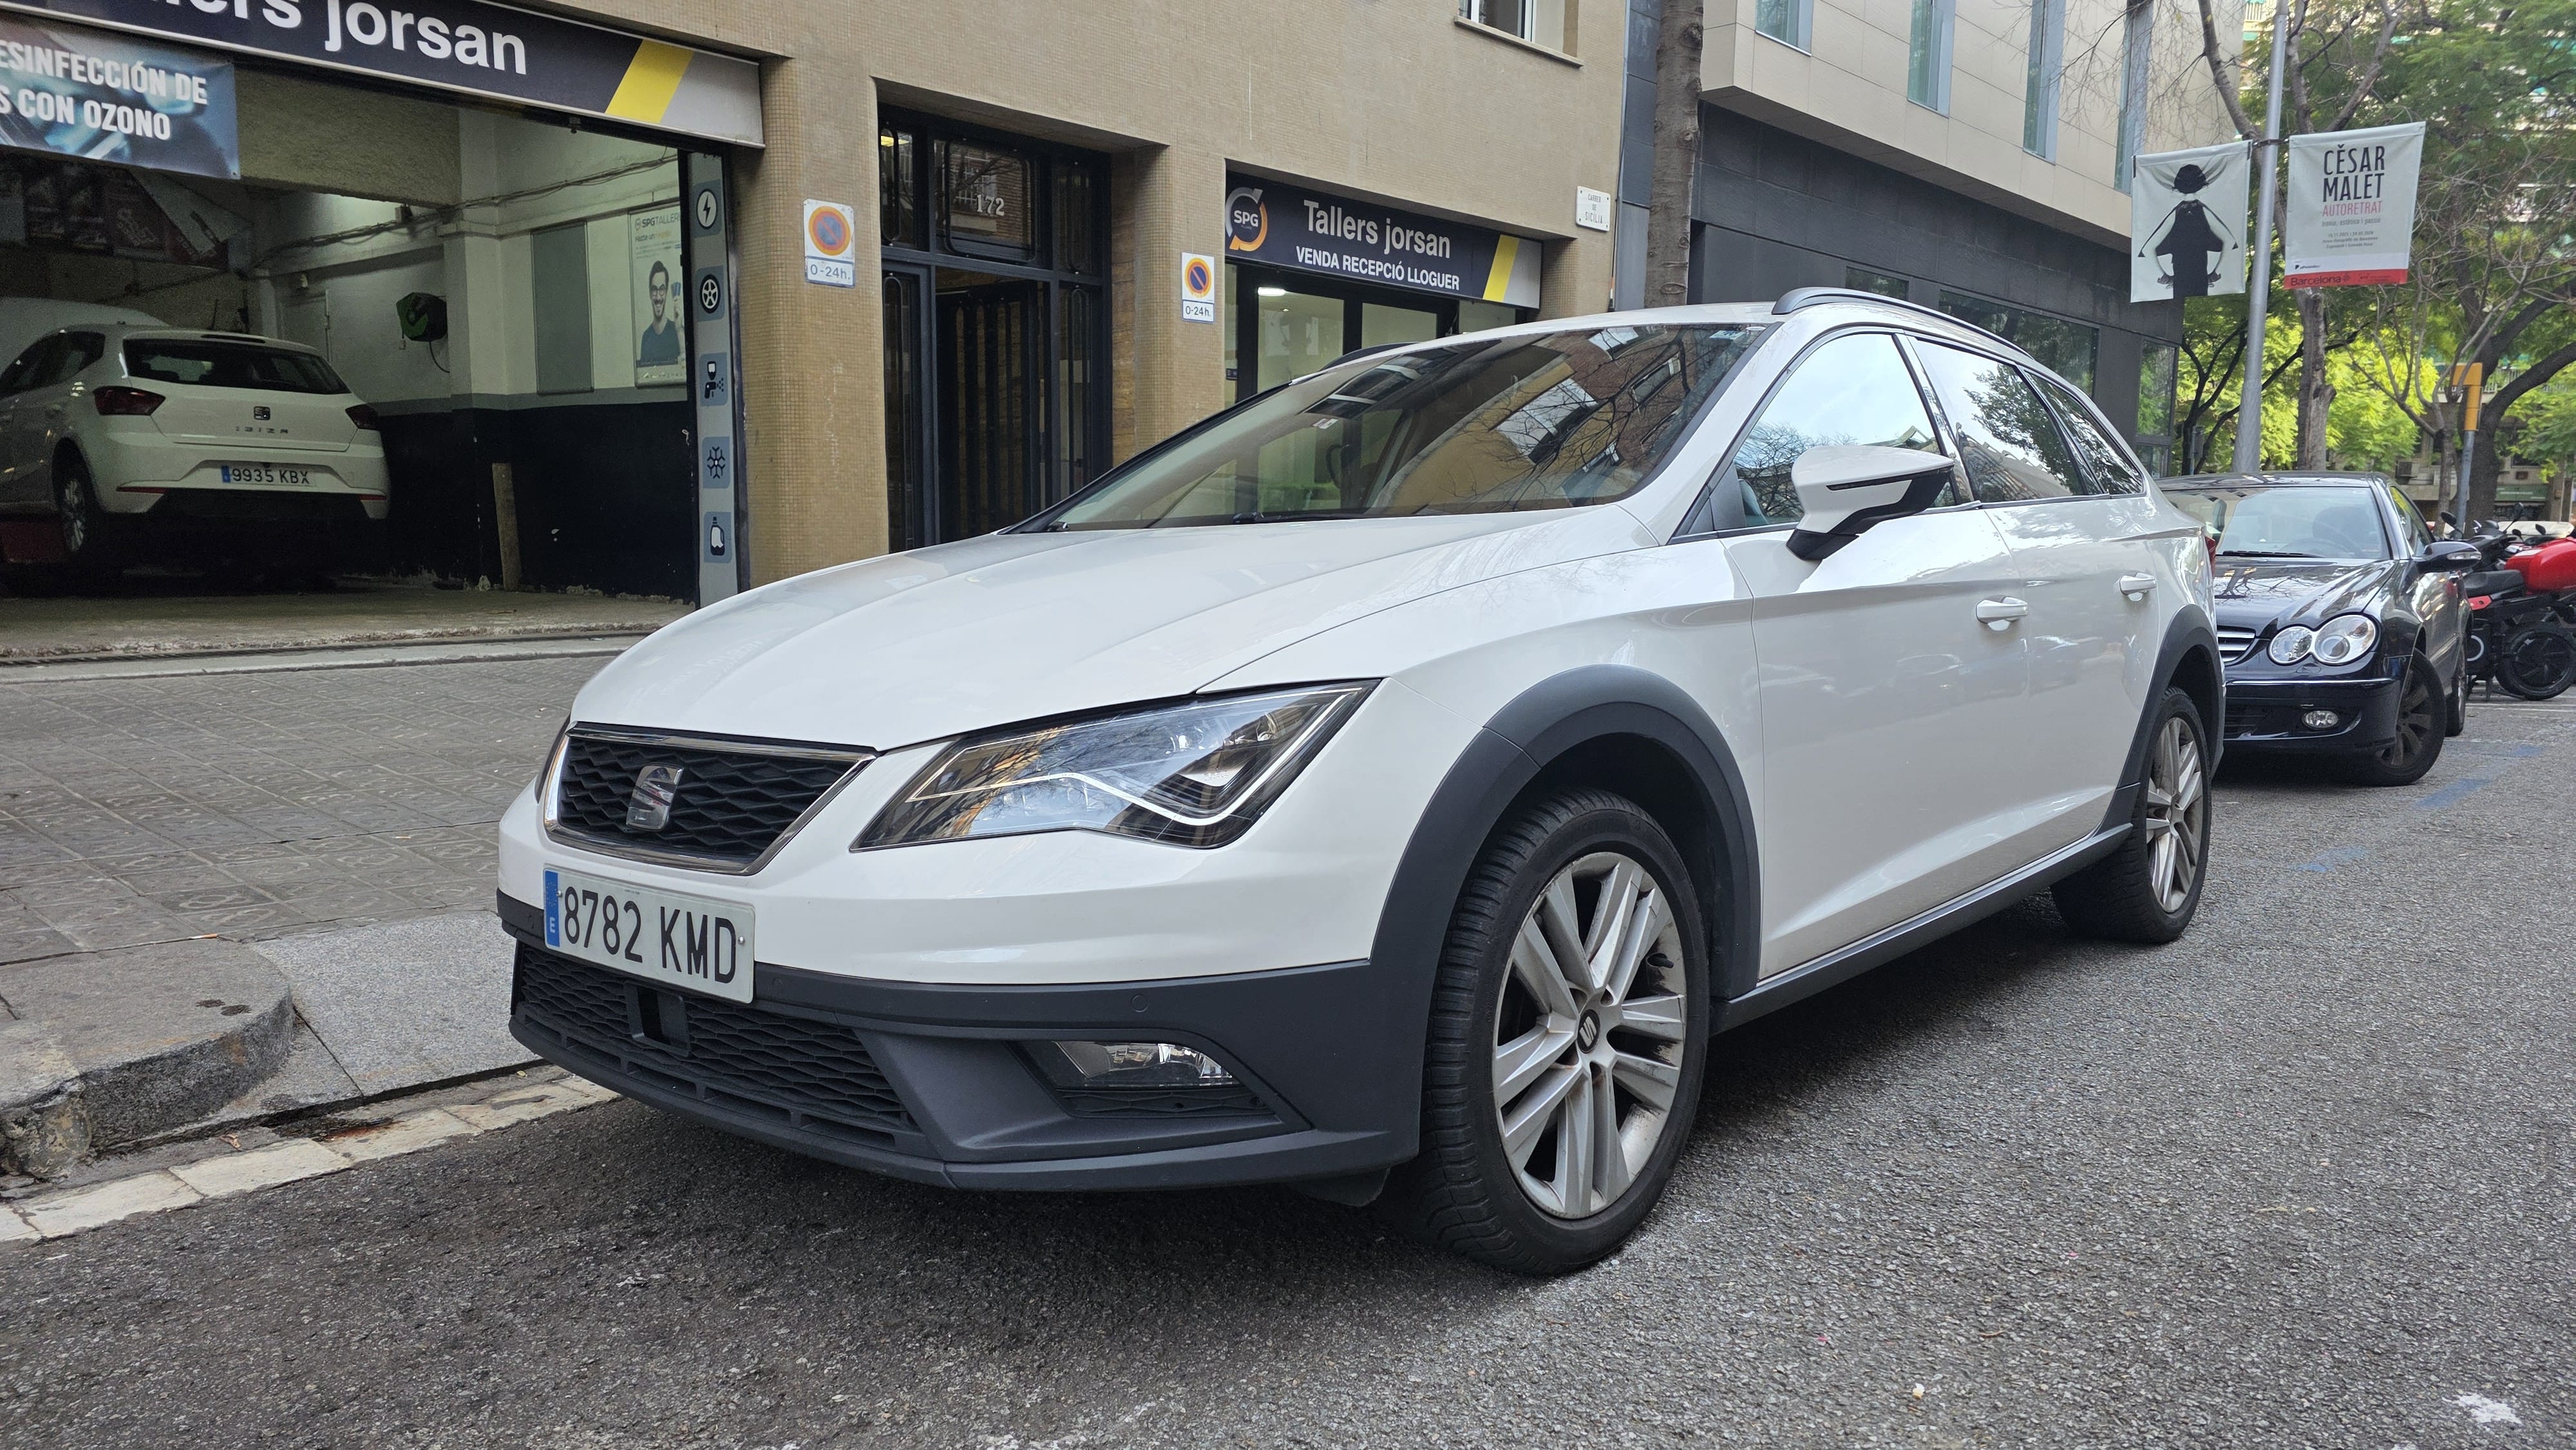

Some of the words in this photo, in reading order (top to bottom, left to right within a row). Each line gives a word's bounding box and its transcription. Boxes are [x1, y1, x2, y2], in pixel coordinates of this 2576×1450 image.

[325, 0, 526, 75] jorsan
[175, 73, 207, 104] DE
[17, 89, 75, 124] CON
[84, 99, 171, 140] OZONO
[2323, 173, 2385, 202] MALET
[976, 194, 1005, 216] 172
[1234, 210, 1258, 227] SPG
[2322, 201, 2382, 217] AUTORETRAT
[1303, 200, 1378, 244] Tallers
[1385, 218, 1450, 259] jorsan
[1296, 246, 1339, 269] VENDA
[1342, 258, 1405, 281] RECEPCIÓ
[1407, 267, 1459, 290] LLOGUER
[2291, 276, 2342, 287] Barcelona
[232, 468, 274, 483] 9935
[279, 469, 310, 484] KBX
[564, 886, 643, 964] 8782
[660, 906, 736, 984] KMD
